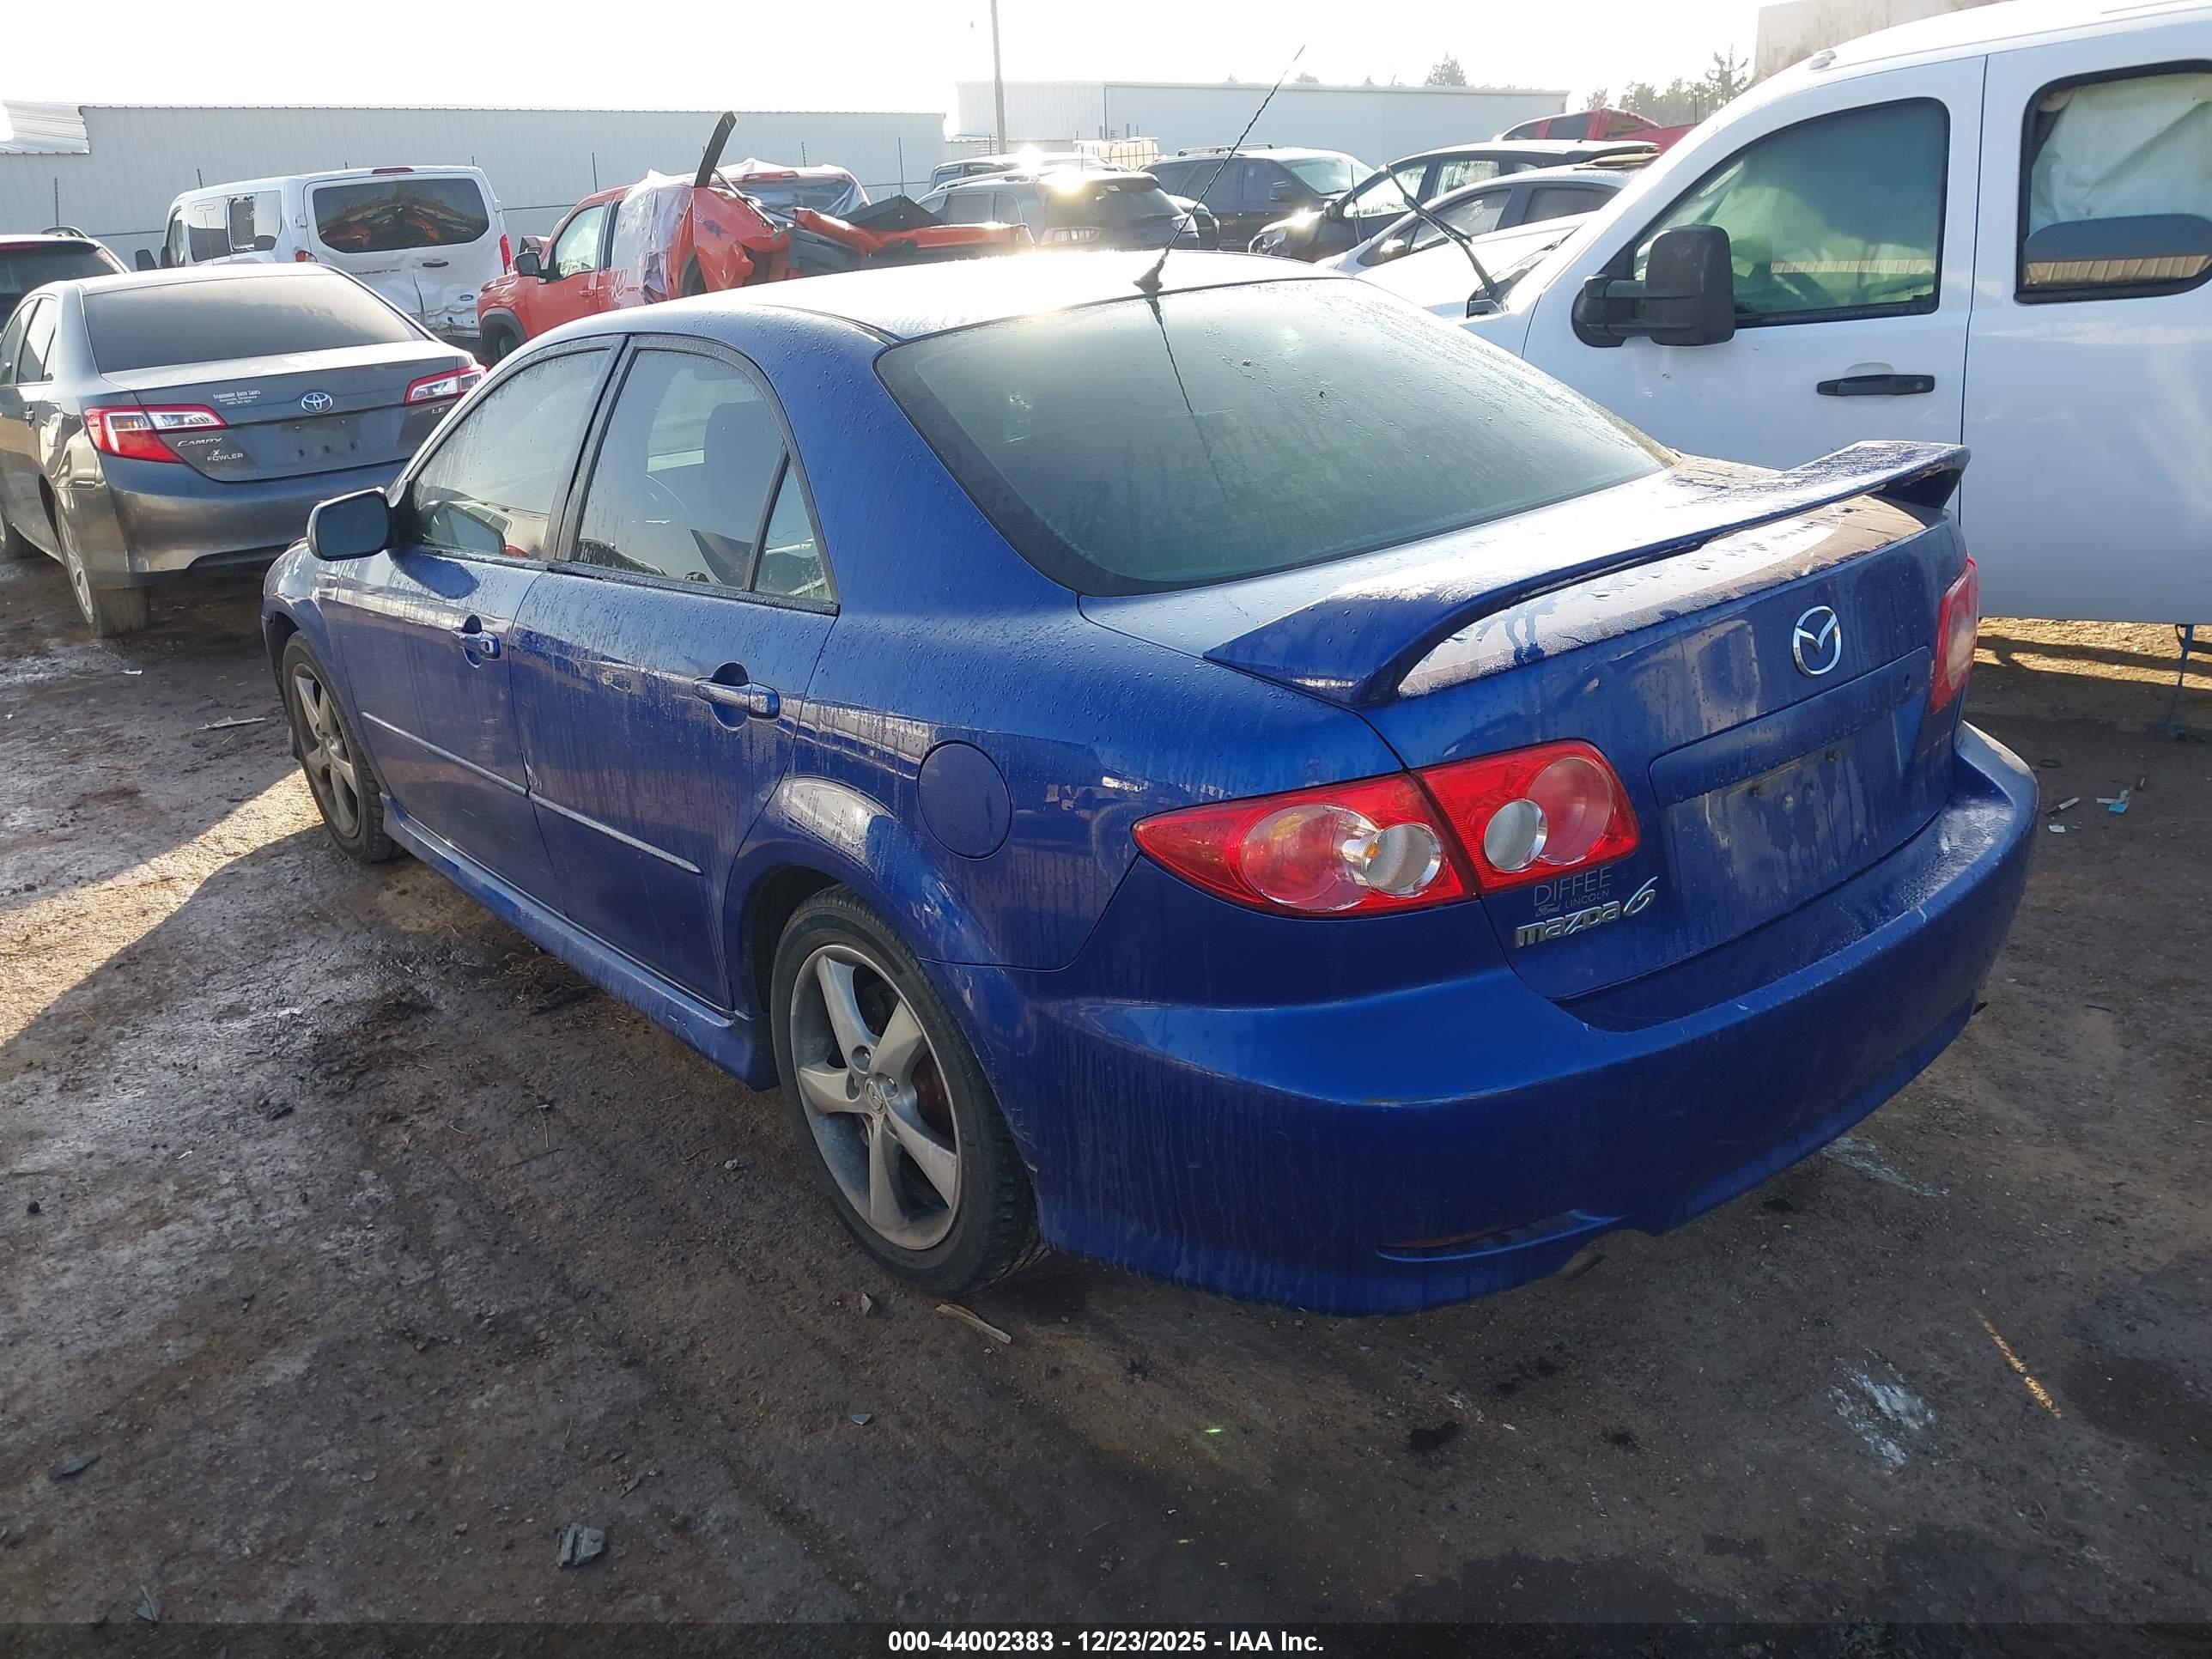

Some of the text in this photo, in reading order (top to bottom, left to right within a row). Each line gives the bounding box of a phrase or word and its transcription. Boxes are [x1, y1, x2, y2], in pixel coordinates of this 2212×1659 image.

[177, 437, 223, 447] CAMRY
[207, 453, 244, 462] FOWLER
[1534, 866, 1613, 907] DIFFEE
[1565, 889, 1610, 909] LINCOLN
